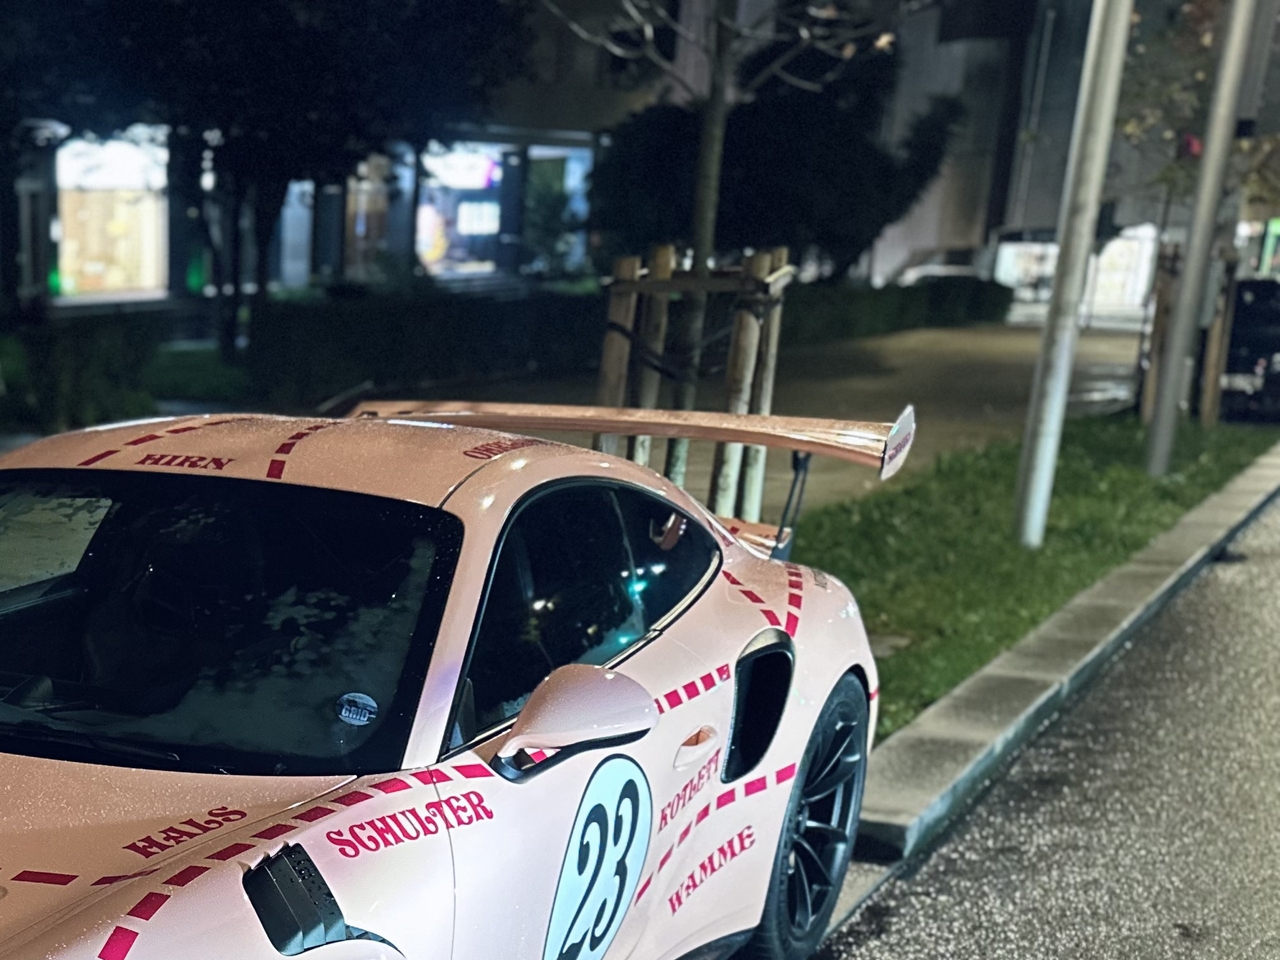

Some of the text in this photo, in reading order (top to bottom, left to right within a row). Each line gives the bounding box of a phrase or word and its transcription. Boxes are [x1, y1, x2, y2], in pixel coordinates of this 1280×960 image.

[135, 453, 235, 471] HIRN
[122, 805, 249, 859] HALS
[326, 790, 494, 858] SCHULTER
[668, 825, 757, 916] WAMME
